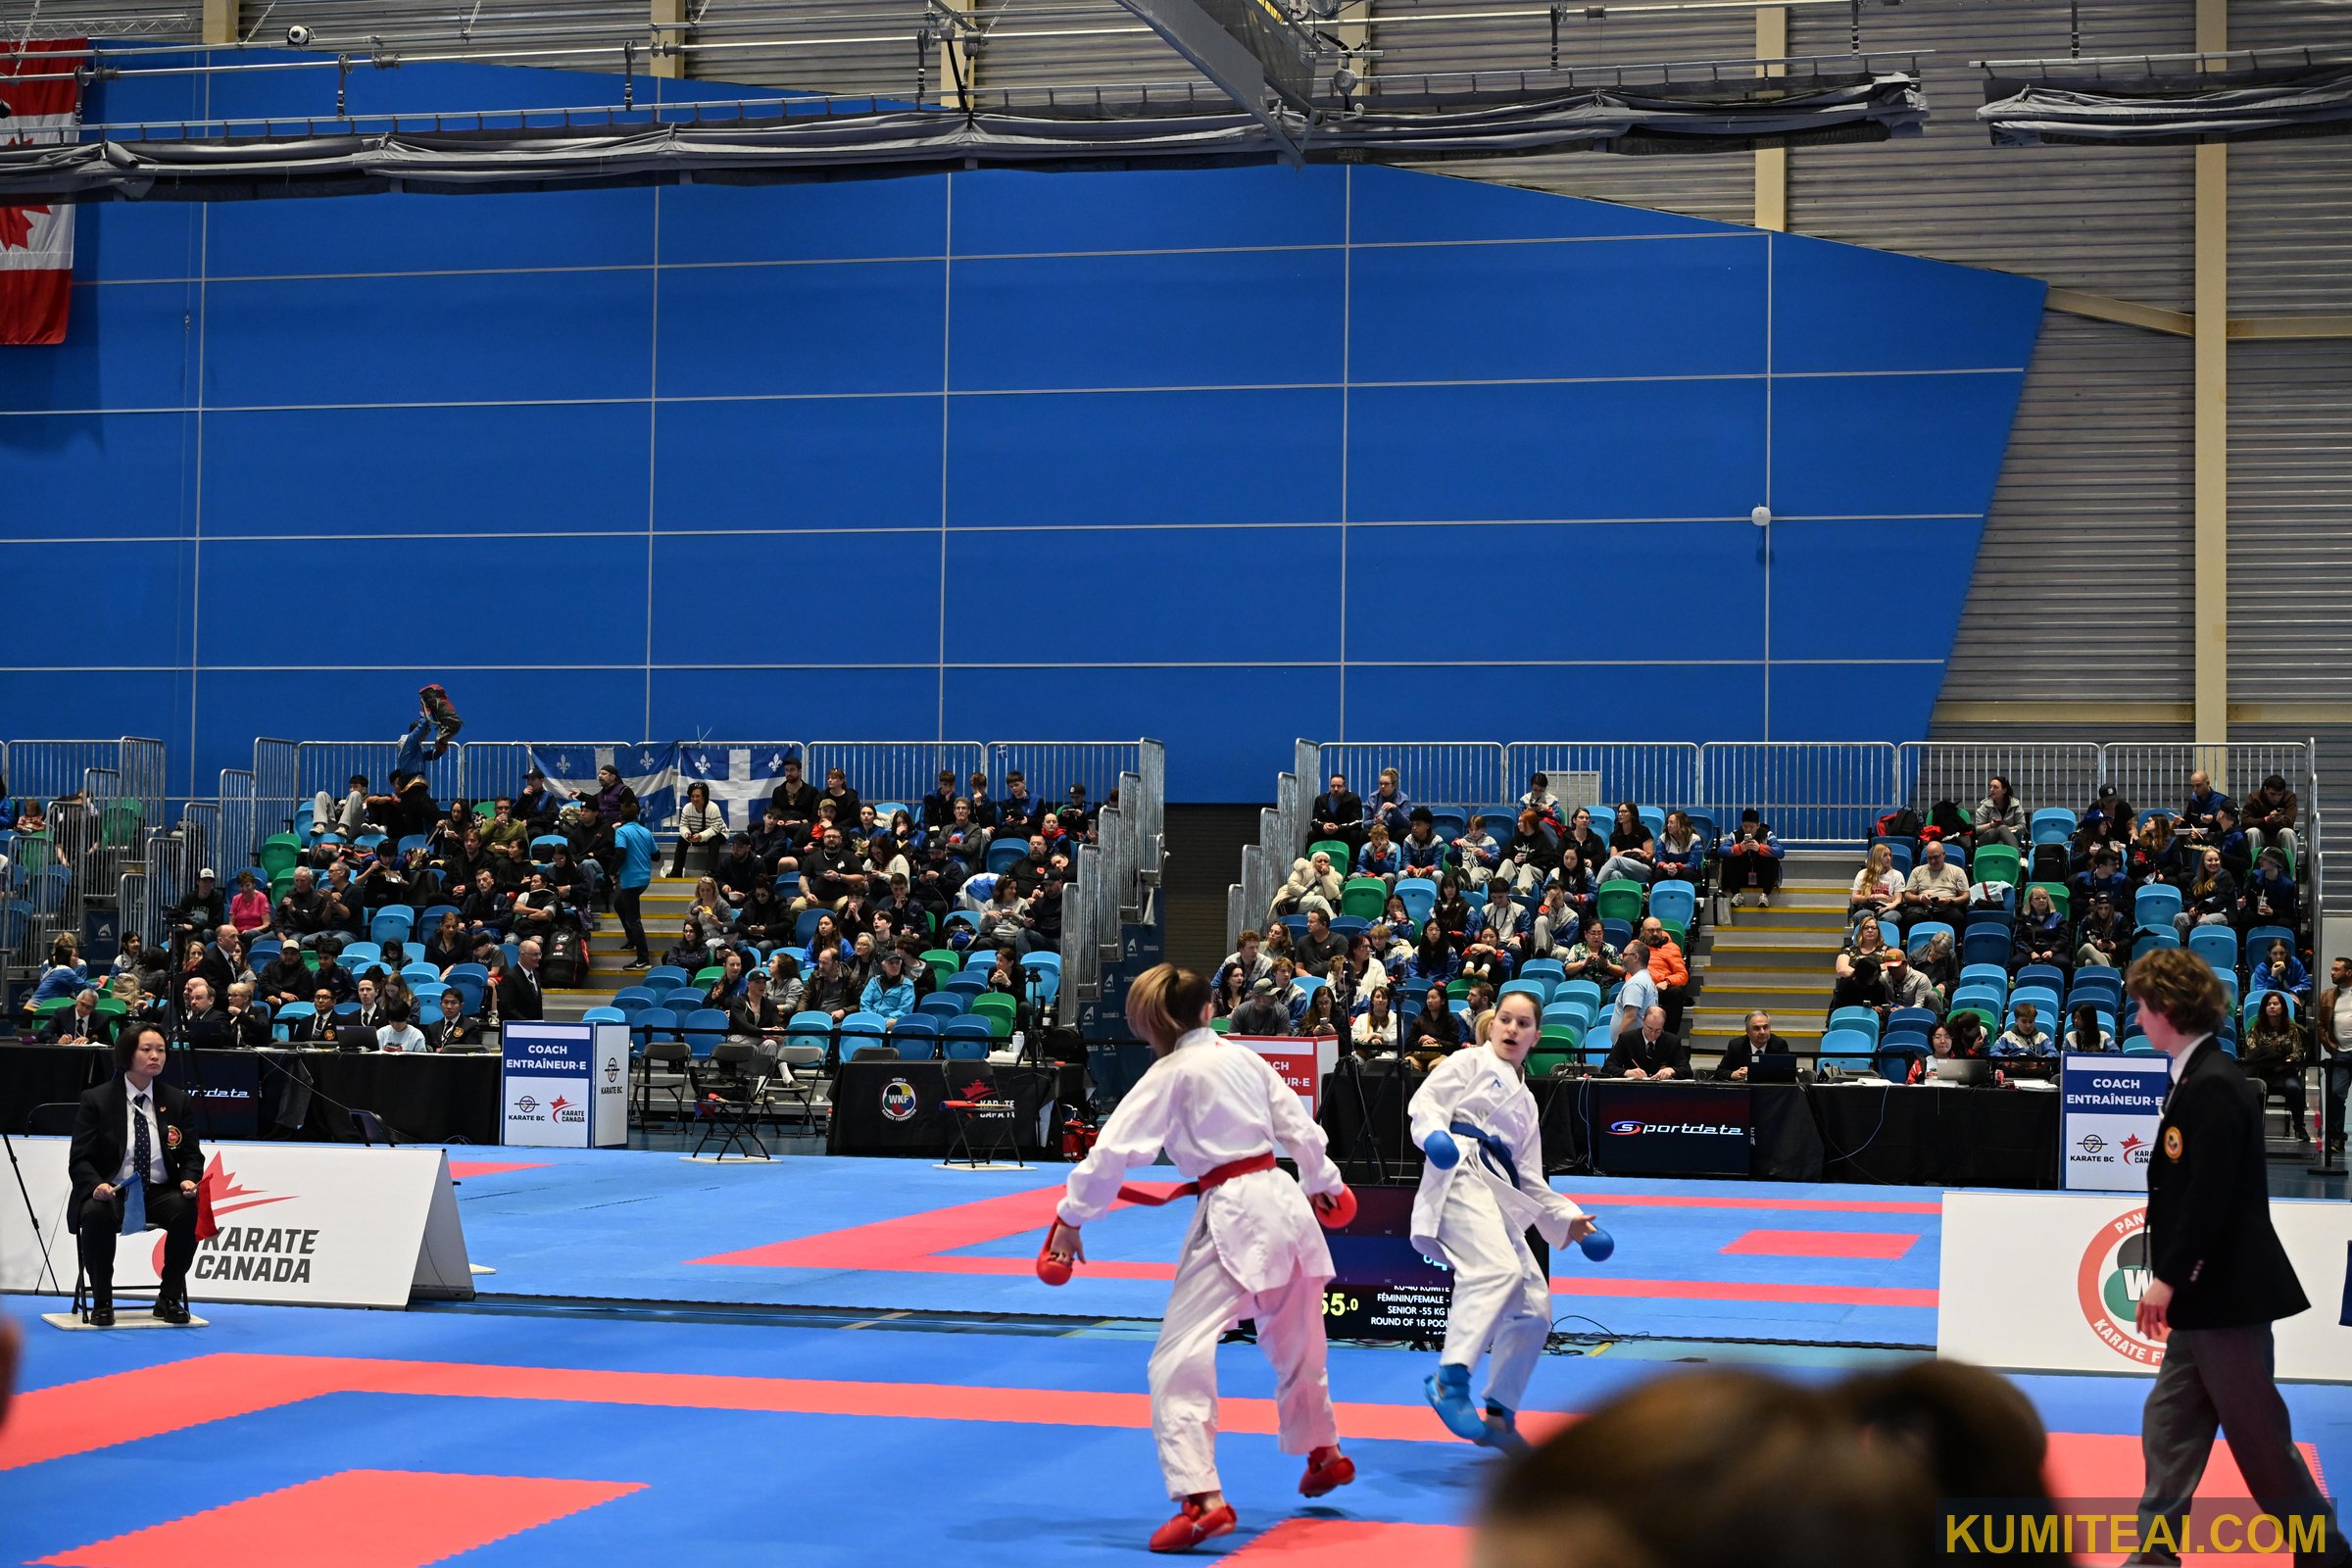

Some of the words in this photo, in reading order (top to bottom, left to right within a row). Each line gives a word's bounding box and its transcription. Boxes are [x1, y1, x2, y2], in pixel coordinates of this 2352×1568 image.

[527, 1045, 567, 1054] COACH
[506, 1058, 587, 1070] ENTRAÎNEUR·E
[2092, 1078, 2140, 1089] COACH
[601, 1086, 616, 1095] KARATE
[888, 1095, 909, 1104] WKF
[201, 1226, 320, 1254] KARATE
[194, 1254, 311, 1284] CANADA
[1377, 1292, 1444, 1303] FÉMININ/FEMALE
[1387, 1305, 1417, 1315] SENIOR
[1418, 1306, 1432, 1316] -55
[1434, 1307, 1446, 1316] KG
[1371, 1316, 1401, 1326] ROUND
[1402, 1317, 1414, 1327] OF
[1416, 1318, 1426, 1327] 16
[2093, 1318, 2147, 1360] KARATE
